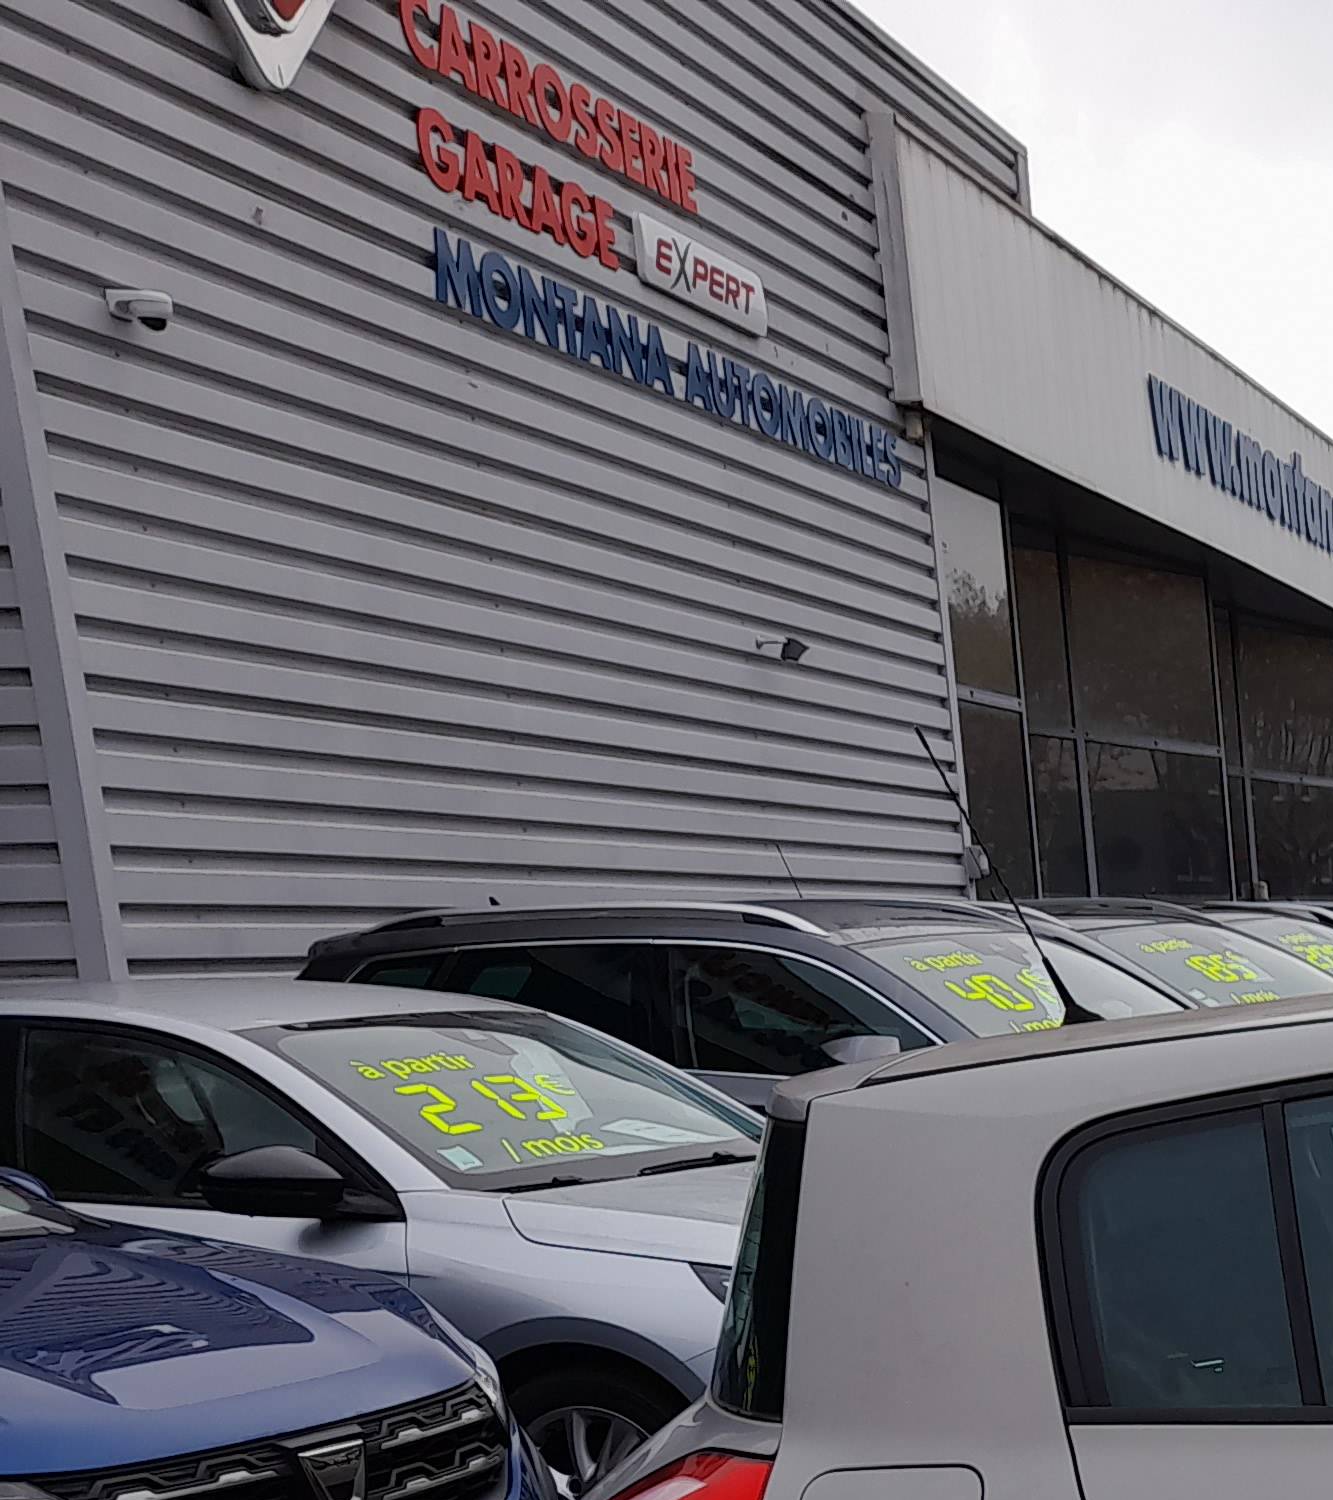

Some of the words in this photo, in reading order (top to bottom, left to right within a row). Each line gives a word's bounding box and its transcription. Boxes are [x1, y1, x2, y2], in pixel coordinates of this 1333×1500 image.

[400, 0, 698, 213] CARROSSERIE
[416, 107, 619, 271] GARAGE
[655, 236, 755, 315] EXPERT
[434, 227, 674, 396] MONTANA
[685, 340, 901, 489] AUTOMOBILES
[349, 1059, 386, 1081] à
[381, 1051, 478, 1081] partir
